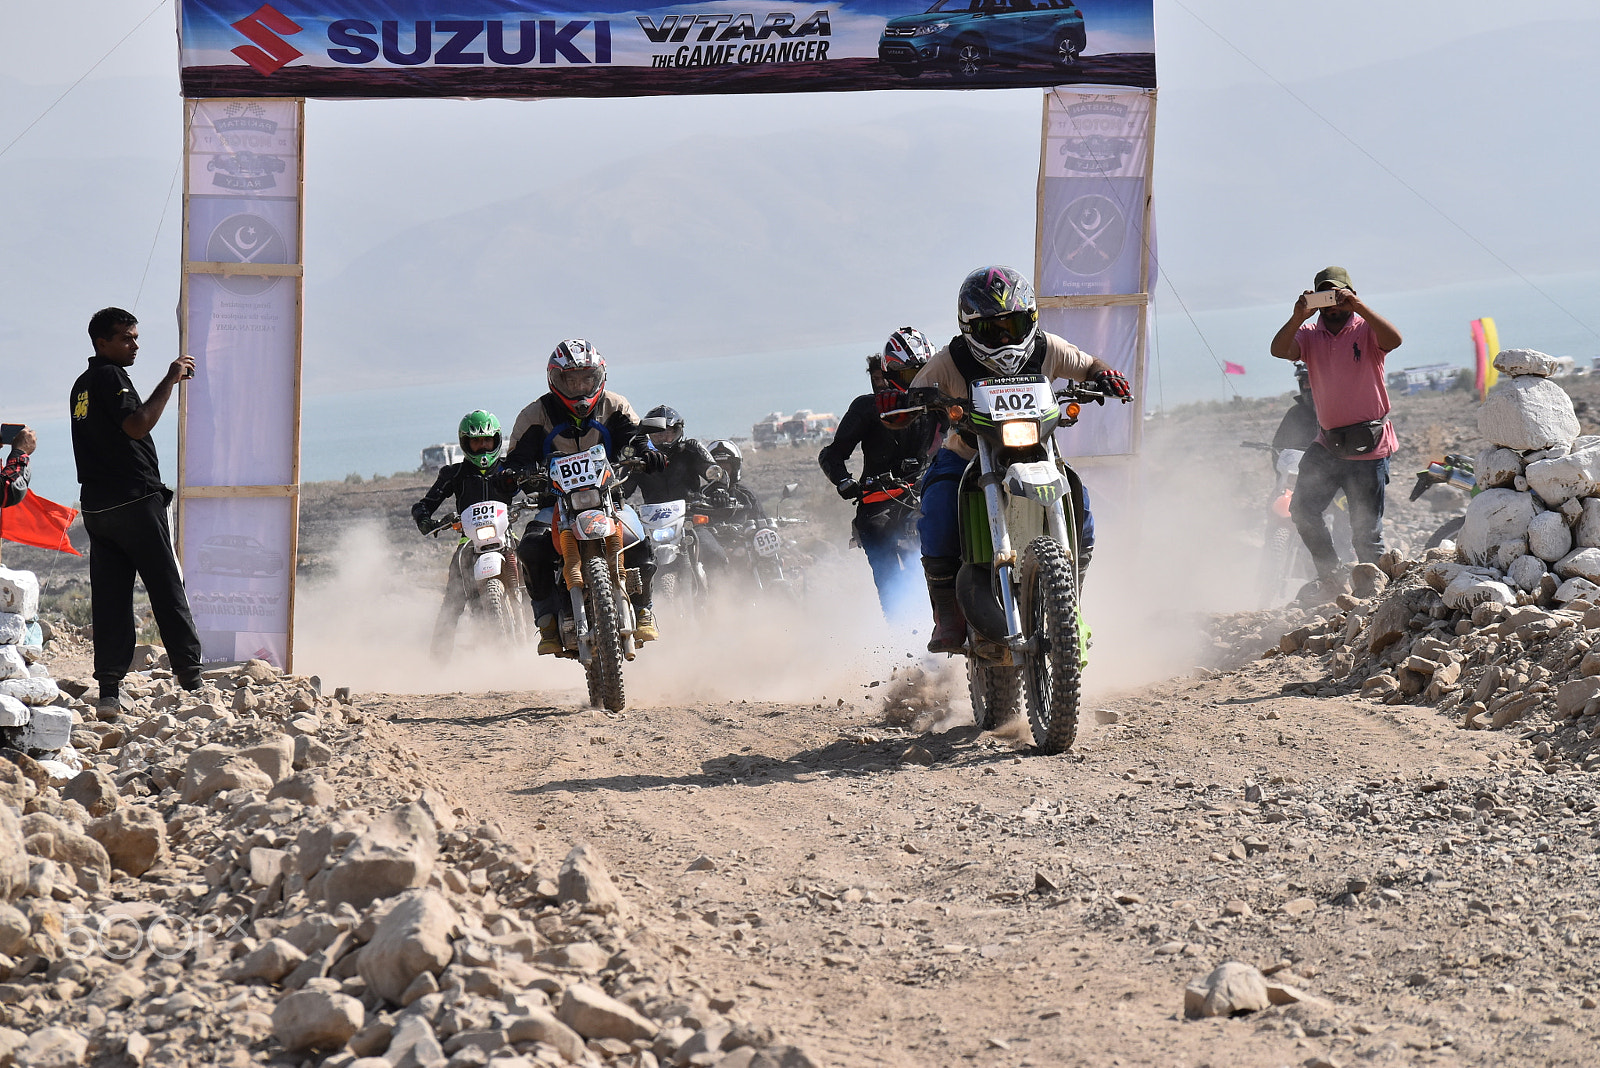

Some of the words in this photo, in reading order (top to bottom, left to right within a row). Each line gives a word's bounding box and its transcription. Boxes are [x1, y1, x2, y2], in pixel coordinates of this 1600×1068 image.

[636, 10, 832, 43] VITARA
[326, 19, 612, 65] SUZUKI
[652, 54, 674, 69] THE
[674, 44, 736, 69] GAME
[737, 41, 830, 65] CHANGER
[994, 393, 1036, 412] A02
[560, 459, 590, 479] B07
[473, 505, 495, 517] B01
[756, 532, 777, 548] B15
